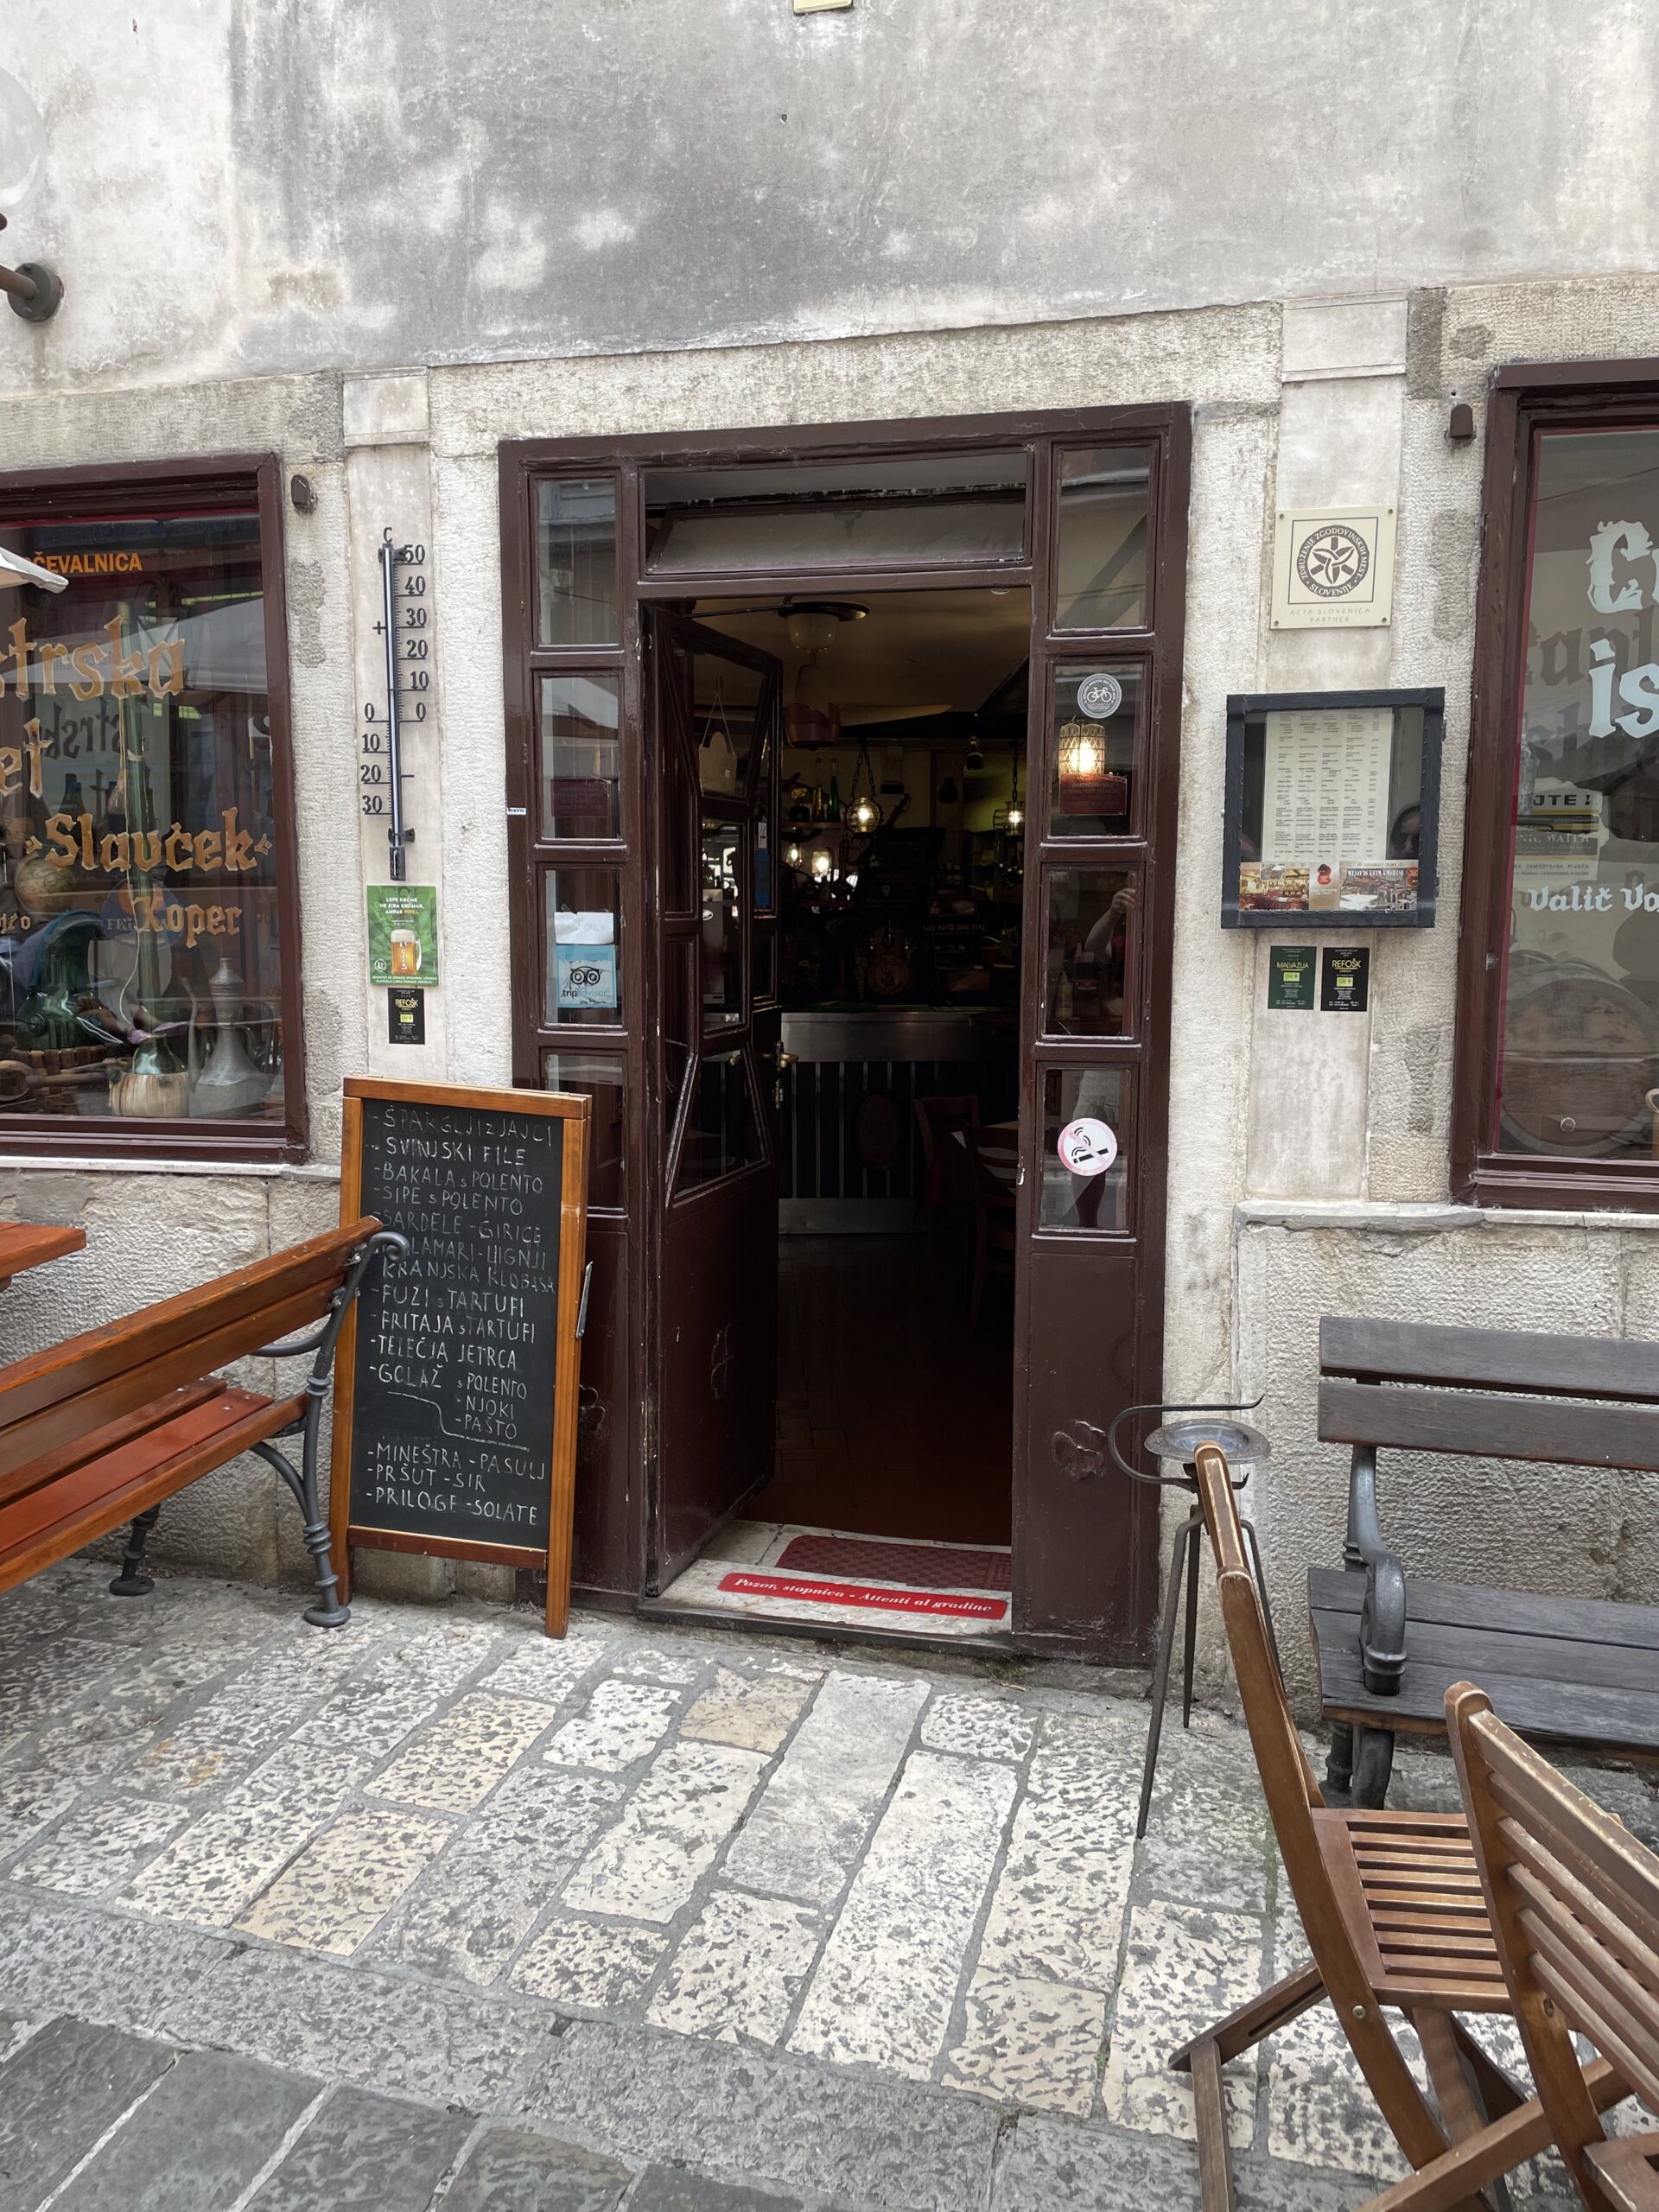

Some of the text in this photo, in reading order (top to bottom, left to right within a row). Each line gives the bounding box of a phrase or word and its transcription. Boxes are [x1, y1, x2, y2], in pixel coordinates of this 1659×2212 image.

[24, 551, 143, 574] ČEVALNICA
[404, 544, 426, 563] 50
[1314, 527, 1368, 556] ZGODOVINSKIH
[1357, 556, 1368, 579] MEST
[1586, 520, 1659, 613] C
[405, 576, 426, 594] 40
[1309, 582, 1354, 596] SLOVENIJE
[406, 608, 427, 626] 30
[0, 615, 185, 702] trska
[407, 639, 429, 658] 20
[410, 671, 429, 690] 10
[365, 702, 427, 721] 0 0
[362, 733, 380, 752] 10
[360, 765, 382, 783] 20
[362, 796, 383, 814] 30
[1529, 882, 1659, 912] Valič Vo
[132, 884, 242, 949] Koper
[1332, 957, 1362, 968] REFOŠK
[395, 997, 419, 1007] REFOŠK
[483, 1146, 526, 1166] FILE
[472, 1170, 543, 1194] POLENTO
[442, 1189, 523, 1217] POLENTO
[448, 1287, 524, 1318] TARTUFI
[466, 1315, 535, 1344] TARTUFI
[457, 1344, 517, 1371] JETRCA
[467, 1372, 528, 1400] POLENTO
[734, 1578, 778, 1592] Pozor,
[782, 1584, 845, 1599] stopnica
[857, 1590, 911, 1605] Attenti
[913, 1598, 931, 1607] al
[931, 1600, 993, 1613] gradino
